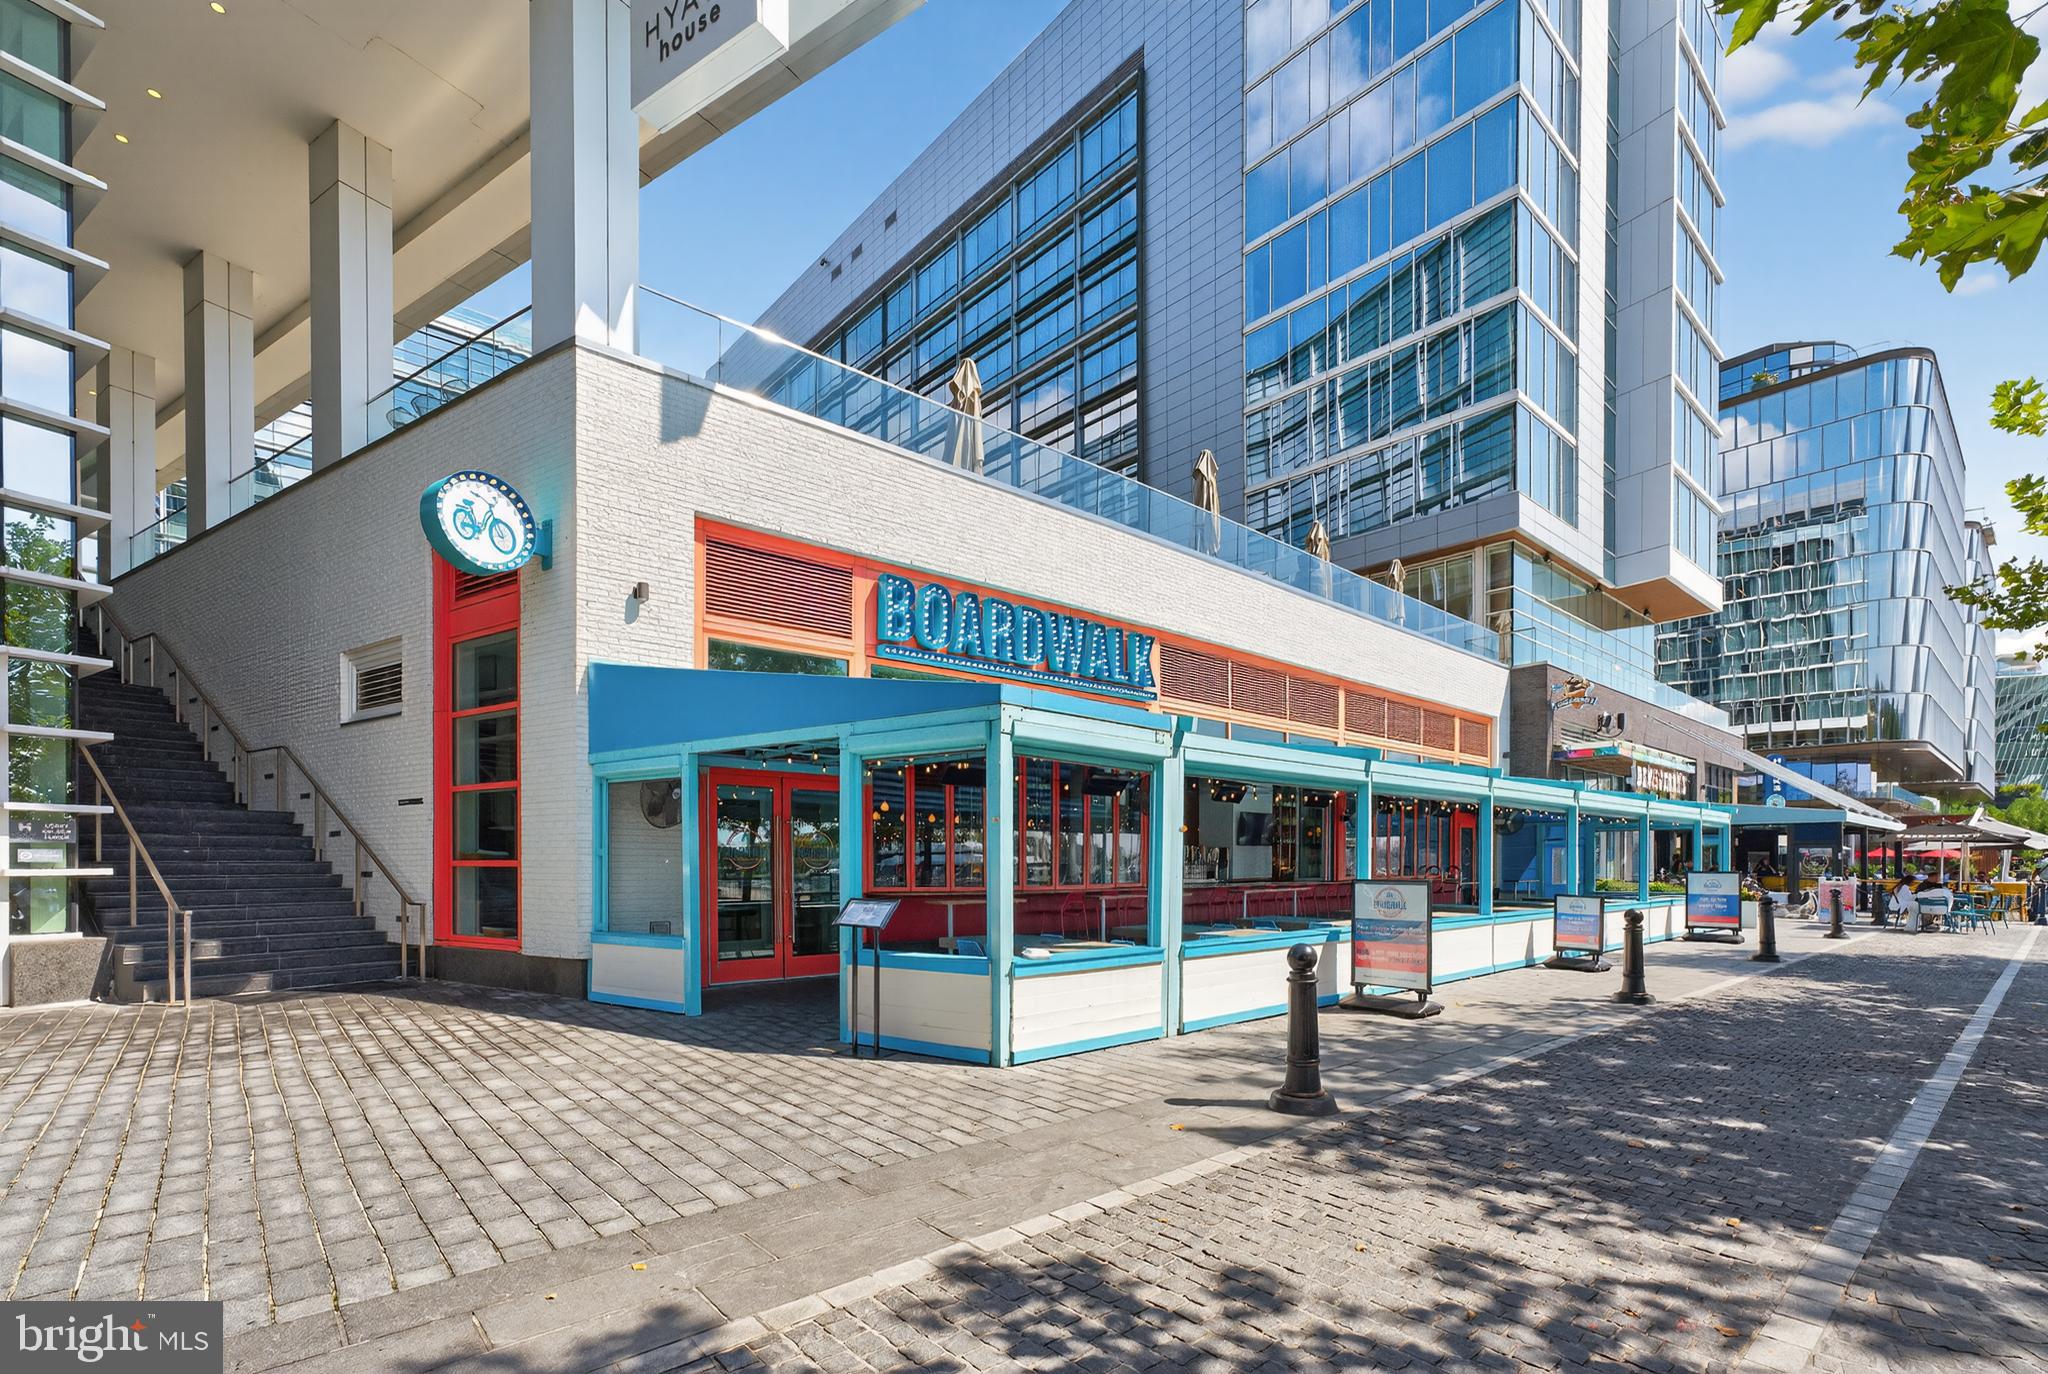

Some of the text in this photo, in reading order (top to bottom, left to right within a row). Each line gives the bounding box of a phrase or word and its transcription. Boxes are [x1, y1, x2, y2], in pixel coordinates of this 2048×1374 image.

[645, 0, 710, 48] HYA
[659, 4, 721, 62] house
[876, 572, 1157, 688] BOARDWALK
